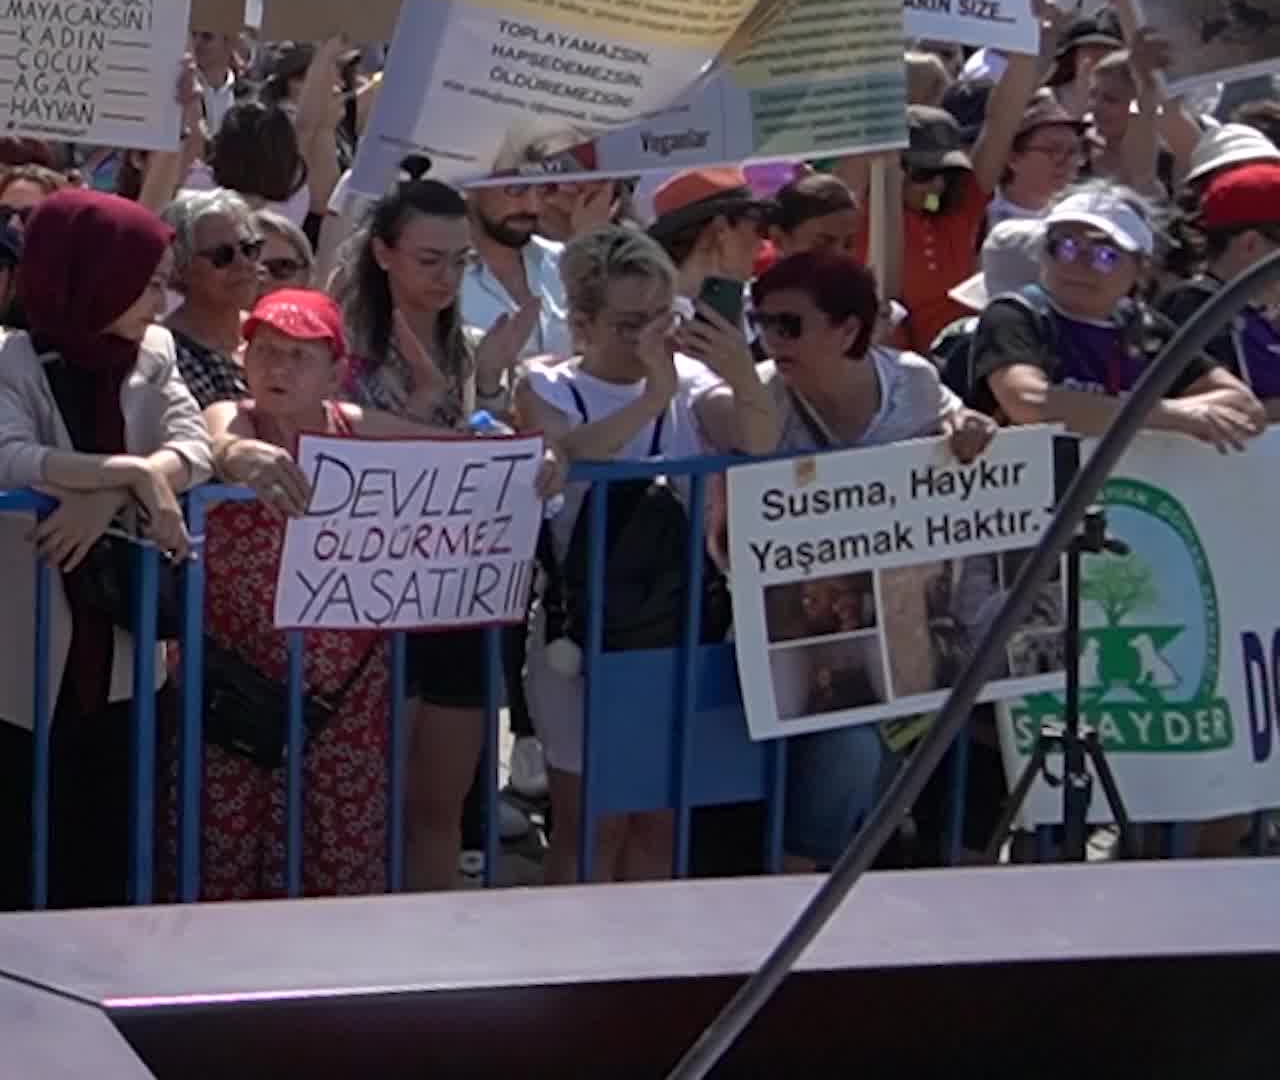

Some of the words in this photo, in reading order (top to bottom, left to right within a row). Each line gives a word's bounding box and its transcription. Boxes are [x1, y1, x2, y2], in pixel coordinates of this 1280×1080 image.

[304, 452, 534, 520] DEVLET
[762, 477, 897, 522] Susma,
[909, 458, 1027, 502] Haykır
[313, 517, 513, 563] ÖLDÜRMEZ
[748, 523, 914, 575] Yaşamak
[1014, 707, 1230, 747] SAYDER
